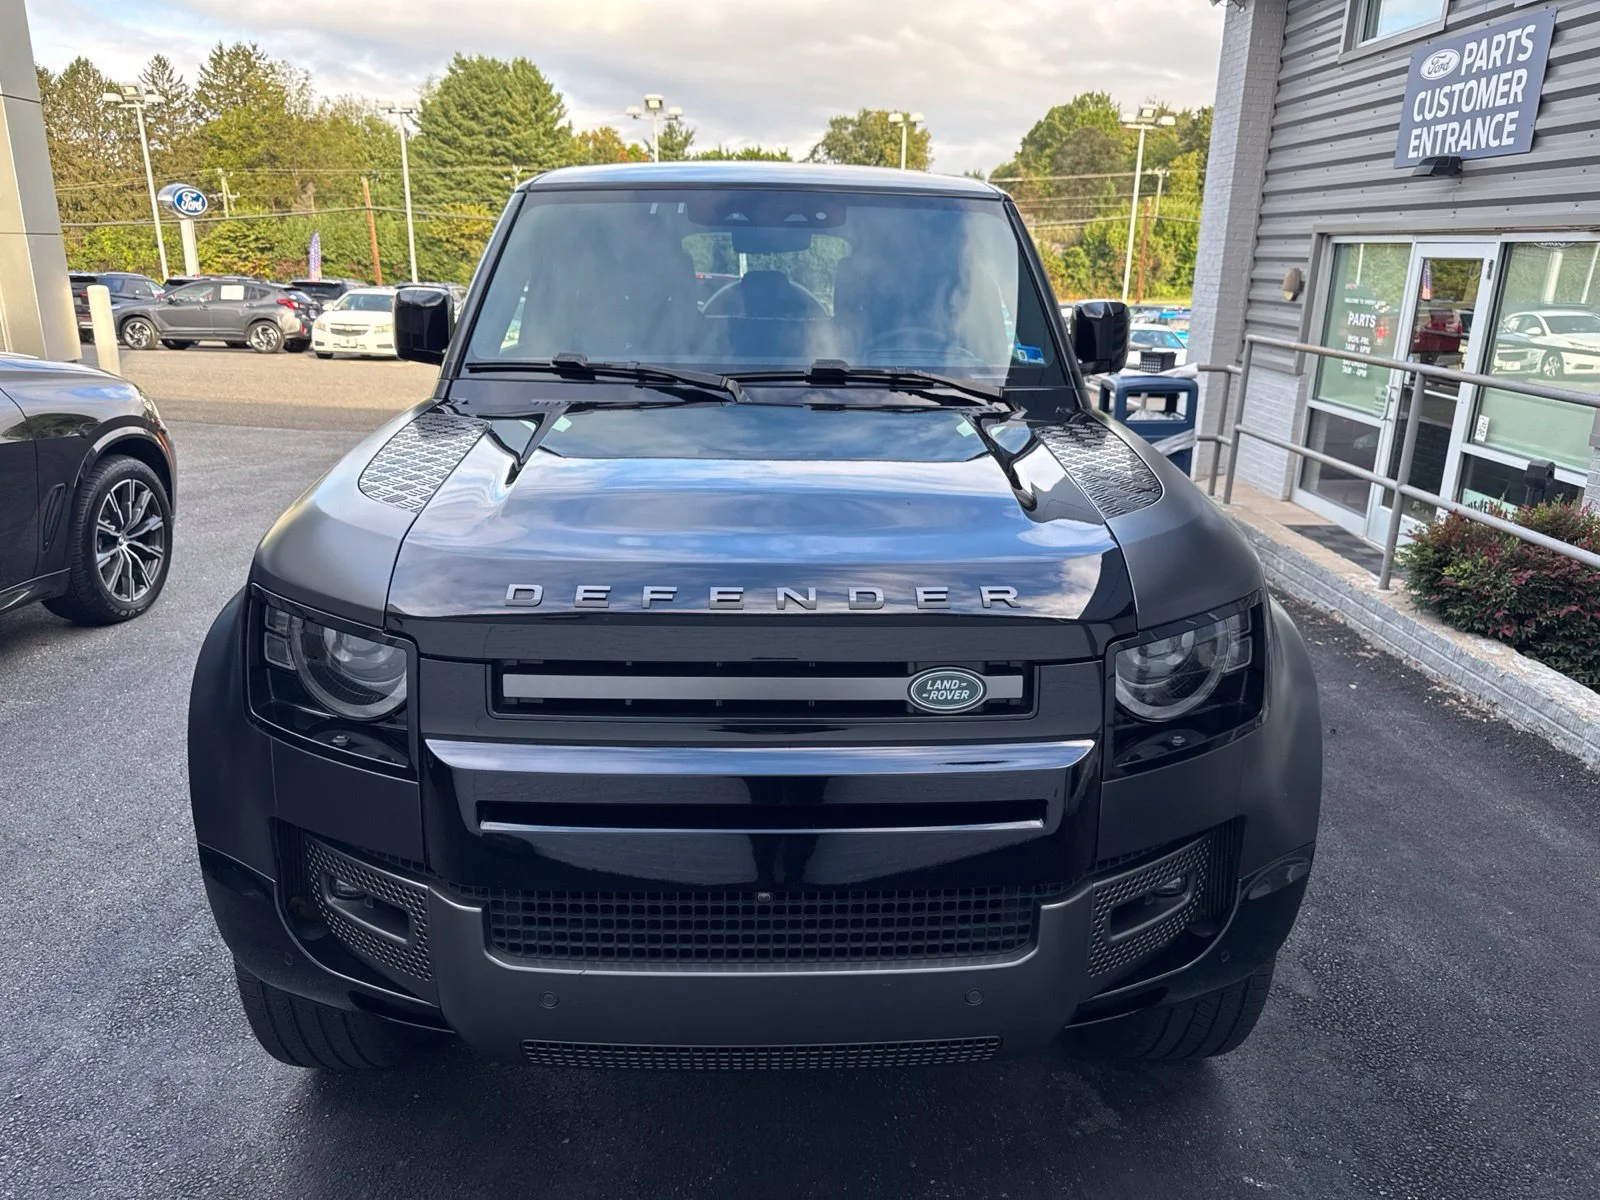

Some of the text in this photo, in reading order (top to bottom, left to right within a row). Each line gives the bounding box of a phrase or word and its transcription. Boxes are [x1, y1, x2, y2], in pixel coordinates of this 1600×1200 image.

[1427, 25, 1536, 76] Ford PARTS
[1413, 69, 1528, 122] CUSTOMER
[1408, 111, 1519, 158] ENTRANCE
[181, 192, 203, 211] Ford
[1347, 312, 1376, 328] PARTS
[505, 583, 1021, 610] DEFENDER
